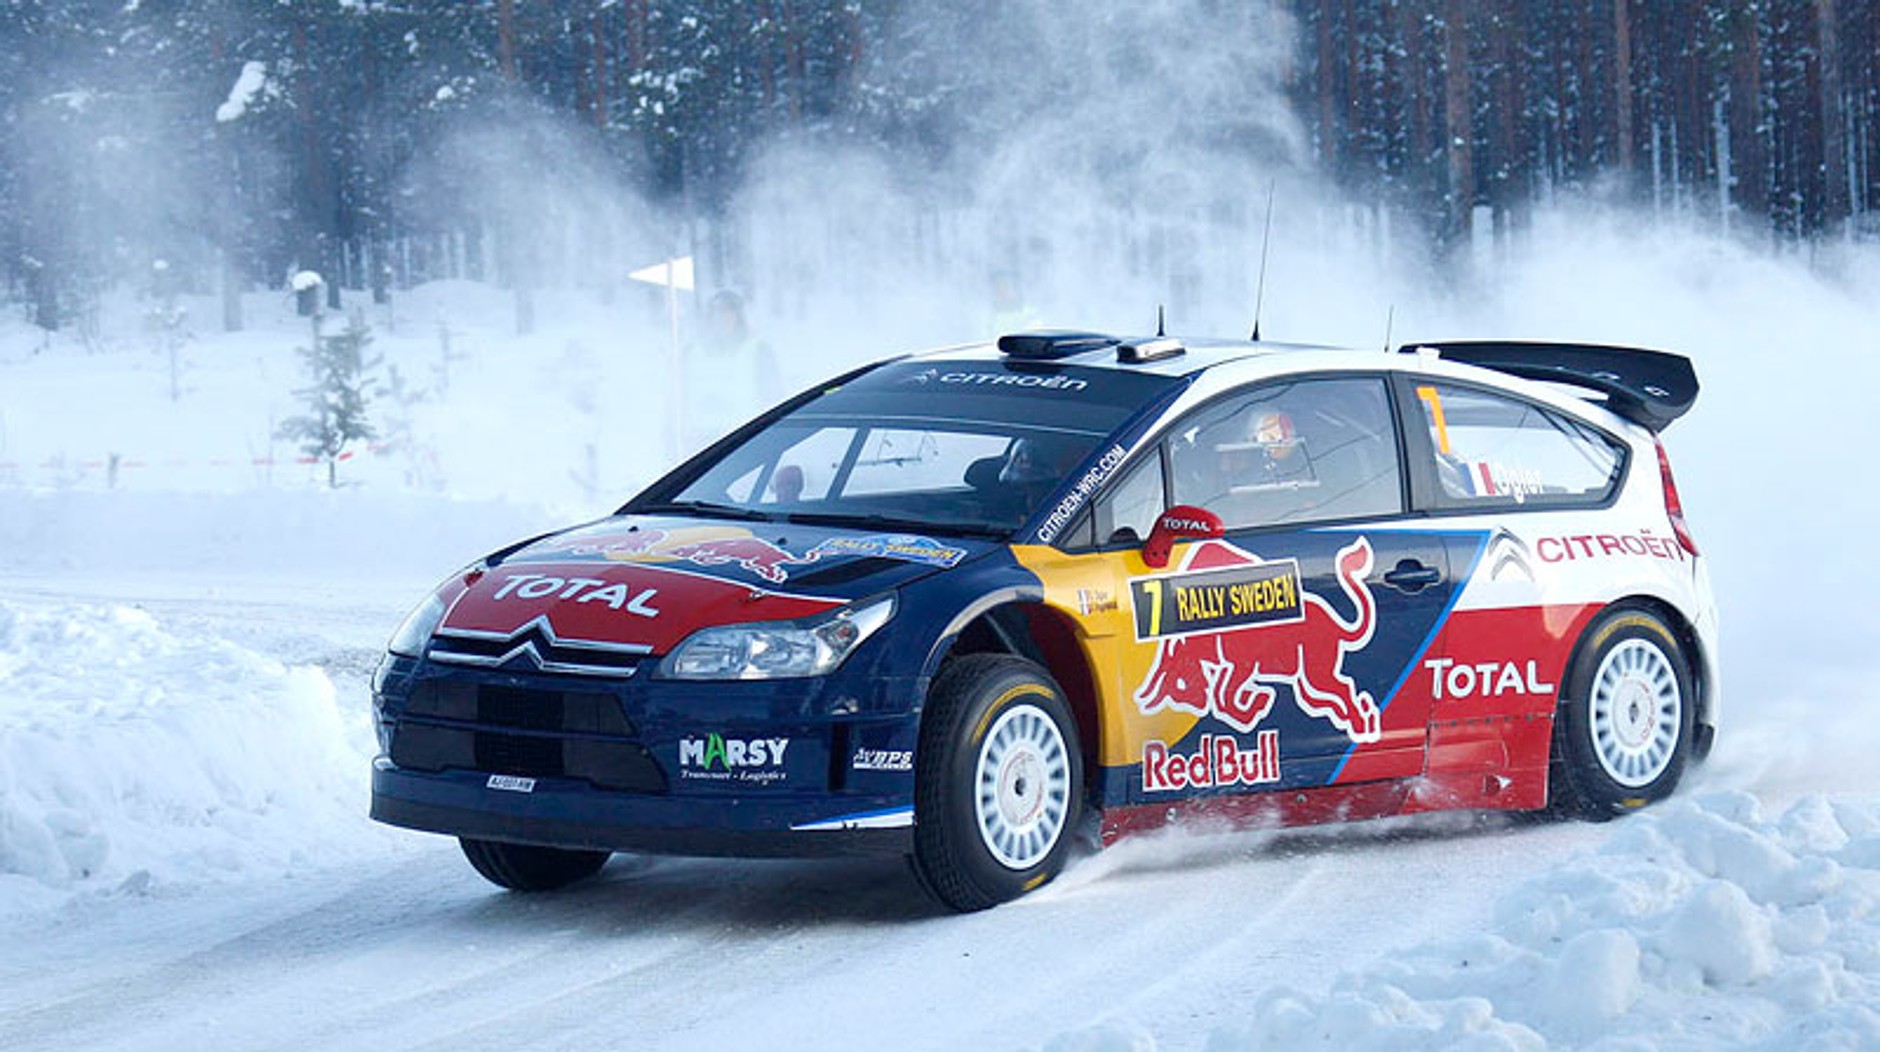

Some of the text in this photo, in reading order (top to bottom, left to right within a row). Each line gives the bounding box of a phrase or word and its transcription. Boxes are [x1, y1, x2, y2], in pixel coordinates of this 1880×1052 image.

[1415, 385, 1450, 455] 7
[1038, 443, 1127, 542] CITROEN-WRC.COM
[1163, 517, 1211, 532] TOTAL
[493, 573, 660, 618] TOTAL
[1142, 573, 1297, 636] 7 RALLY SWEDEN
[1424, 657, 1555, 699] TOTAL
[679, 733, 789, 772] MARSY
[1143, 729, 1281, 792] Red Bull
